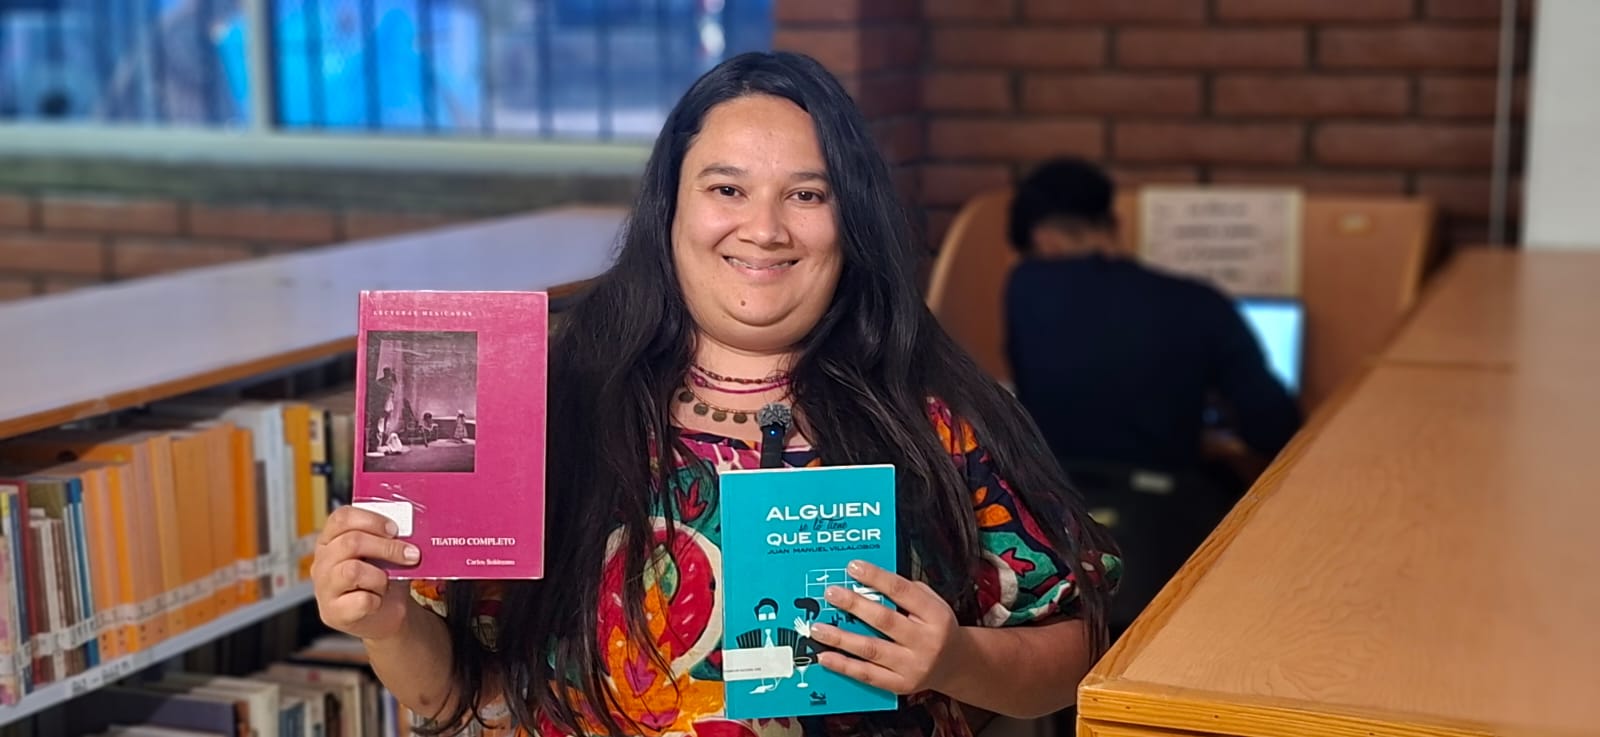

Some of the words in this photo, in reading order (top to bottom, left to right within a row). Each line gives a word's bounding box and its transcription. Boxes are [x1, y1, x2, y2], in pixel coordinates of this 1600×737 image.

[766, 501, 880, 521] ALGUIEN
[431, 537, 466, 546] TEATRO
[466, 537, 516, 546] COMPLETO
[766, 532, 812, 546] QUE
[817, 528, 880, 543] DECIR
[768, 547, 790, 555] JUAN
[793, 545, 828, 553] MANUEL
[829, 543, 880, 552] VILLALOBOS
